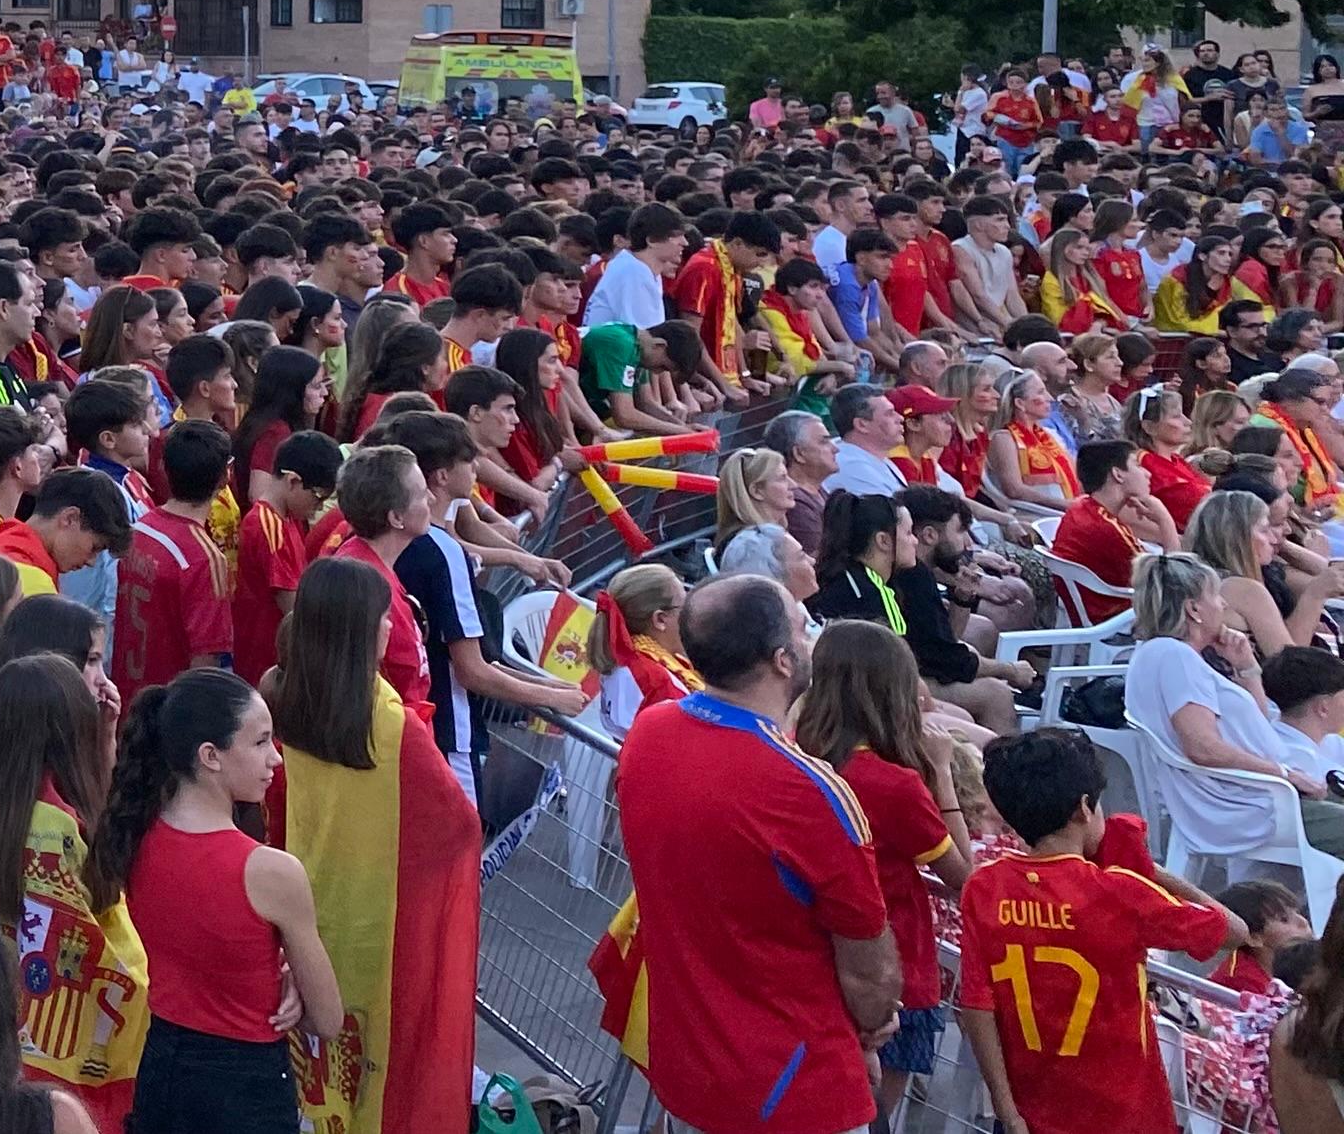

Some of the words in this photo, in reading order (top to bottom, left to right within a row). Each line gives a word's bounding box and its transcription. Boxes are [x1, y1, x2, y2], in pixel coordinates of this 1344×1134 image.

[455, 58, 564, 70] AMBULANCIA
[998, 899, 1076, 930] GUILLE
[990, 943, 1100, 1057] 17
